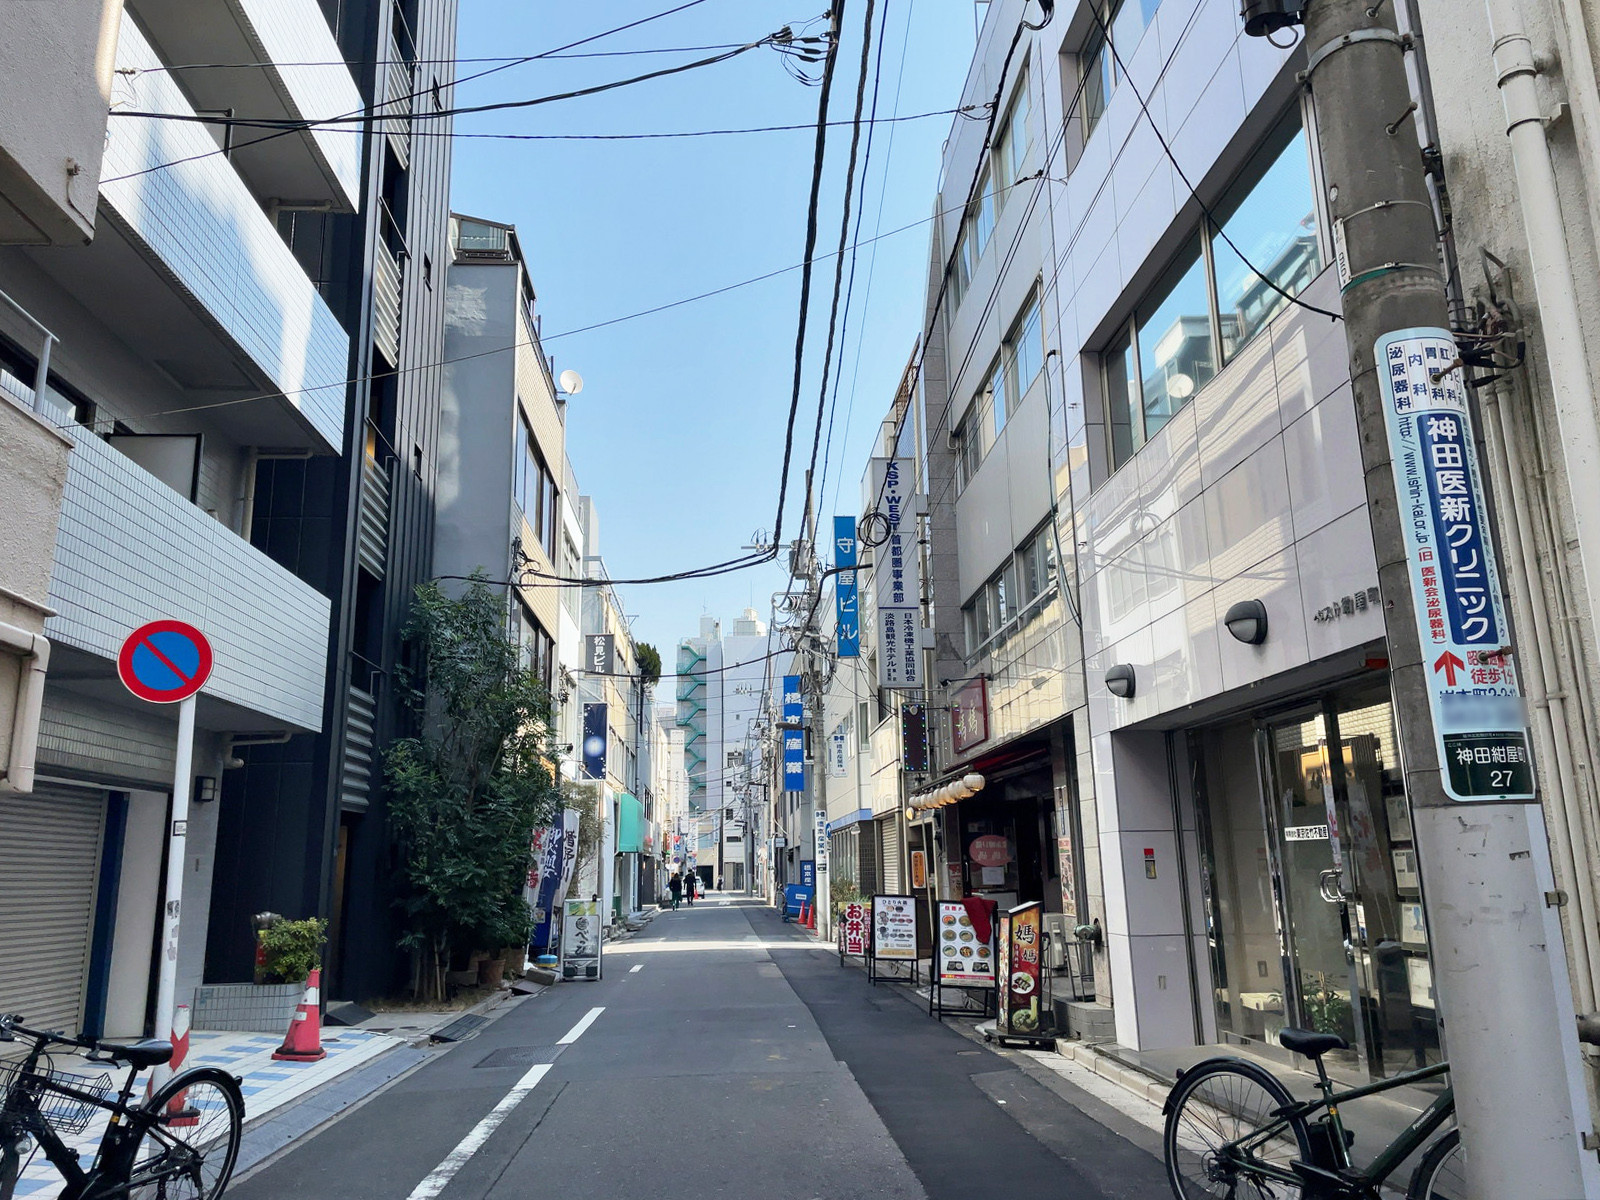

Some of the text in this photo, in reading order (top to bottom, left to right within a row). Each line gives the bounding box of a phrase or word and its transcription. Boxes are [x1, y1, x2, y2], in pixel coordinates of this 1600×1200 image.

[1389, 347, 1411, 410] 泌尿器科
[1408, 353, 1427, 396] 内科
[1398, 416, 1428, 544] http://www.ishin-kai.or.jp
[1427, 416, 1488, 641] 神田医新クリニック
[837, 537, 858, 640] 守屋ビル
[885, 612, 897, 667] 淡路島観光ホテル
[904, 612, 915, 682] 日本冷凍機工業協同組合
[1470, 668, 1514, 686] 徒歩1分
[785, 692, 802, 774] 橋本産業
[1456, 745, 1526, 766] 神田紺屋町
[1490, 770, 1513, 787] 27
[846, 903, 863, 954] お弁当
